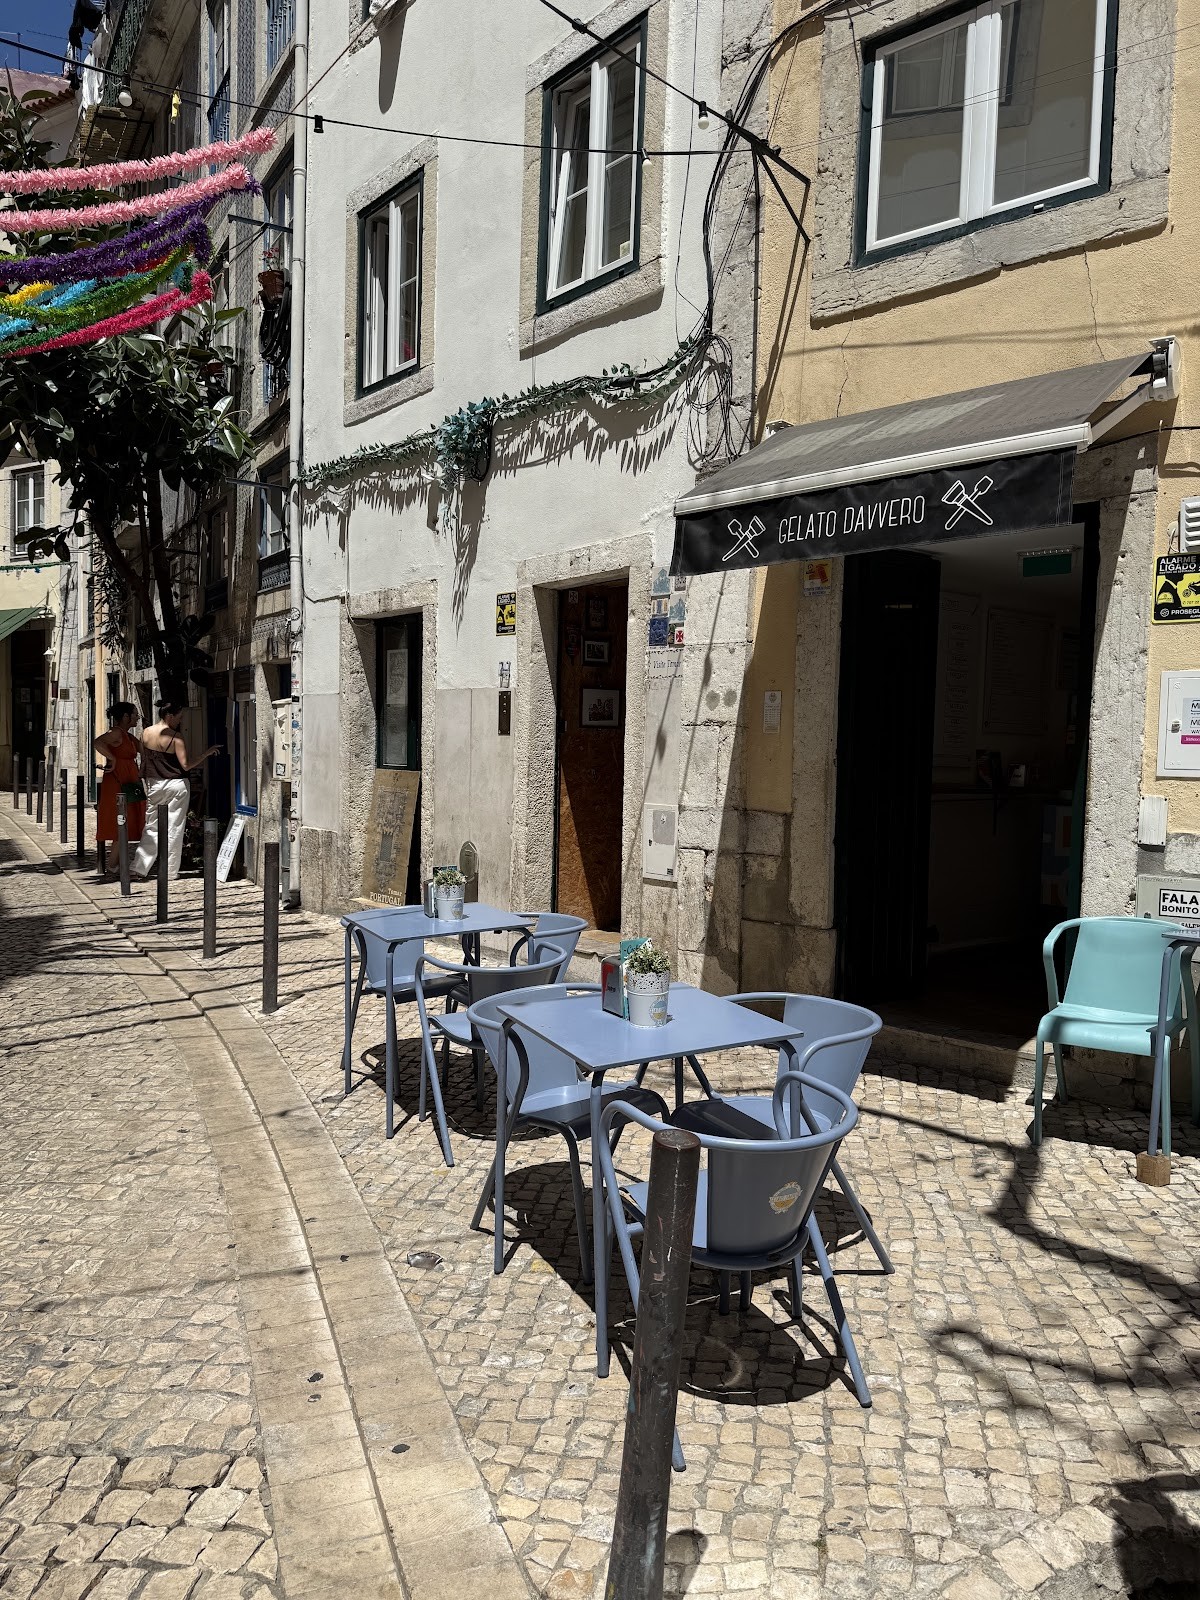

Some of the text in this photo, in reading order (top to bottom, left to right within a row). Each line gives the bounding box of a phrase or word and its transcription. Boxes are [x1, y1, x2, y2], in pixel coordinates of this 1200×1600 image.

[778, 495, 925, 544] GELATO DAVVERO
[1159, 562, 1197, 571] LIGADO
[1160, 556, 1197, 565] ALARME
[370, 891, 402, 906] PORTUGAL
[1162, 892, 1199, 906] FALA
[1161, 904, 1199, 915] BONITO
